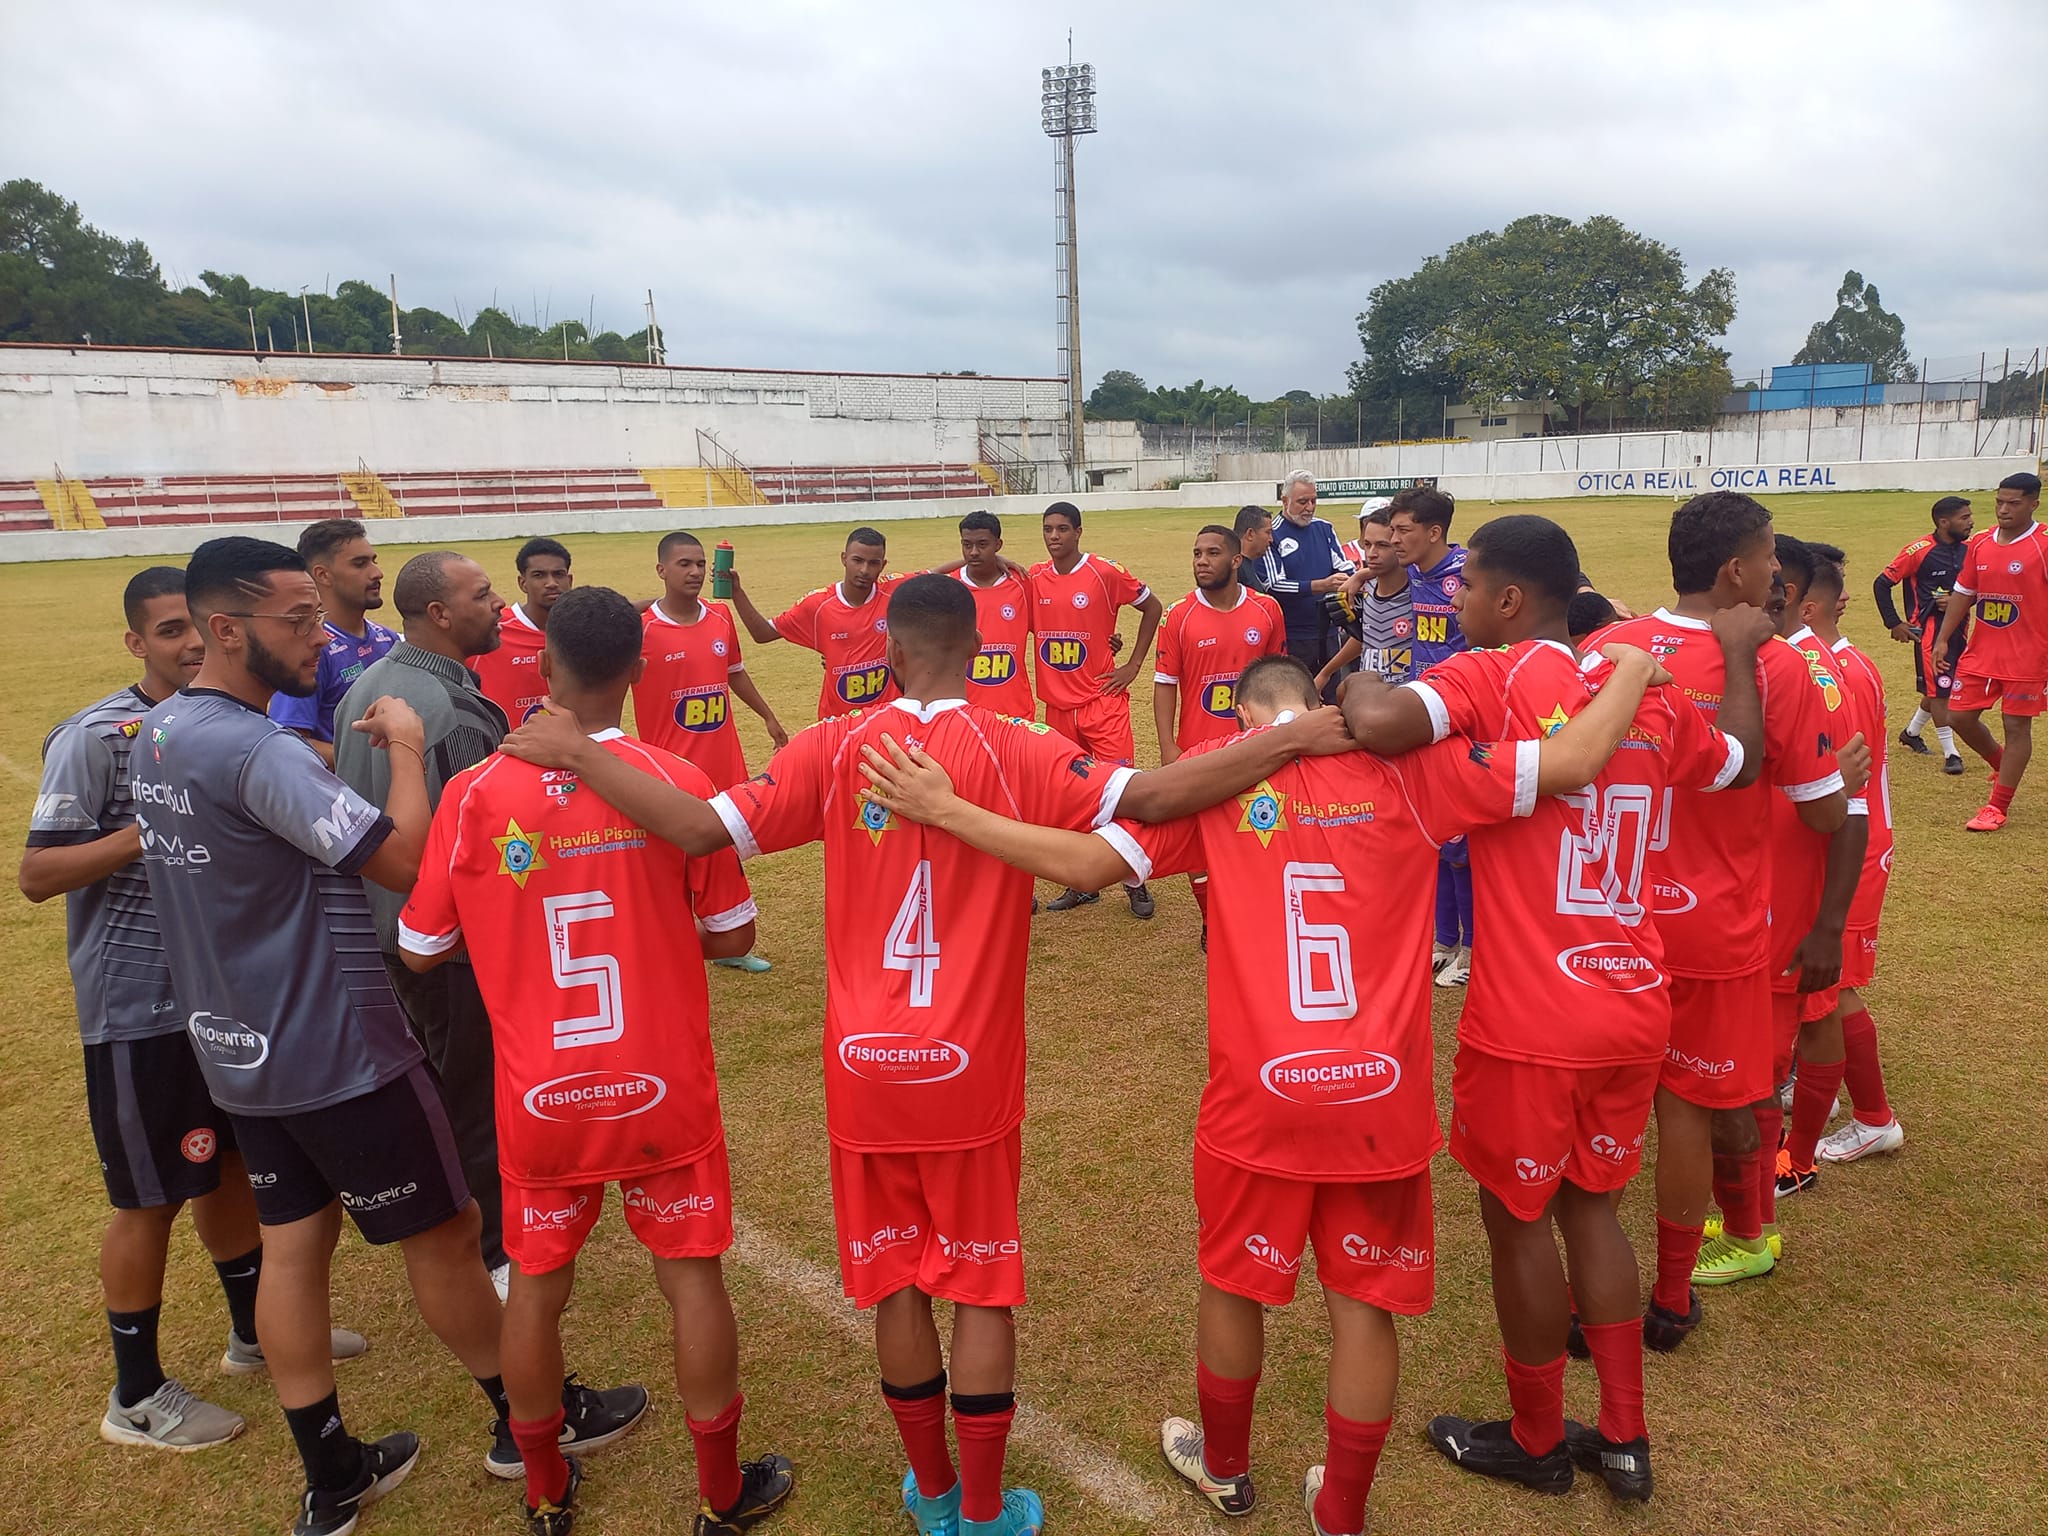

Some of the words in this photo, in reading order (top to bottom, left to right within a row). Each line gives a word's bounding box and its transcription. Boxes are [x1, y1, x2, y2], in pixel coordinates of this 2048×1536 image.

[1338, 479, 1369, 492] VETERANO
[1369, 478, 1390, 490] TERRA
[1391, 477, 1400, 489] DO
[1578, 471, 1636, 491] ÓTICA
[1711, 467, 1769, 488] ÓTICA
[1778, 467, 1837, 487] REAL
[1983, 601, 2012, 624] BH
[1416, 614, 1448, 643] BH
[1049, 641, 1081, 666] BH
[1663, 637, 1687, 646] JCE
[521, 655, 537, 665] JCE
[673, 651, 686, 661] JCE
[972, 653, 1012, 681] BH
[846, 667, 887, 701] BH
[684, 695, 725, 727] BH
[1327, 801, 1375, 817] Pisom
[1606, 809, 1617, 838] JCE
[549, 828, 601, 850] Havilá
[603, 826, 648, 842] Pisom
[557, 838, 647, 859] Gerenciamento
[1554, 782, 1653, 927] 20
[554, 923, 566, 951] JCE
[881, 858, 941, 1009] 4
[1282, 860, 1360, 1023] 6
[542, 889, 626, 1051] 5
[847, 1045, 951, 1064] FISIOCENTER
[1274, 1060, 1388, 1083] FISIOCENTER
[537, 1079, 649, 1109] FISIOCENTER
[340, 1181, 418, 1208] Oliveira
[1600, 1450, 1636, 1473] PUMA
